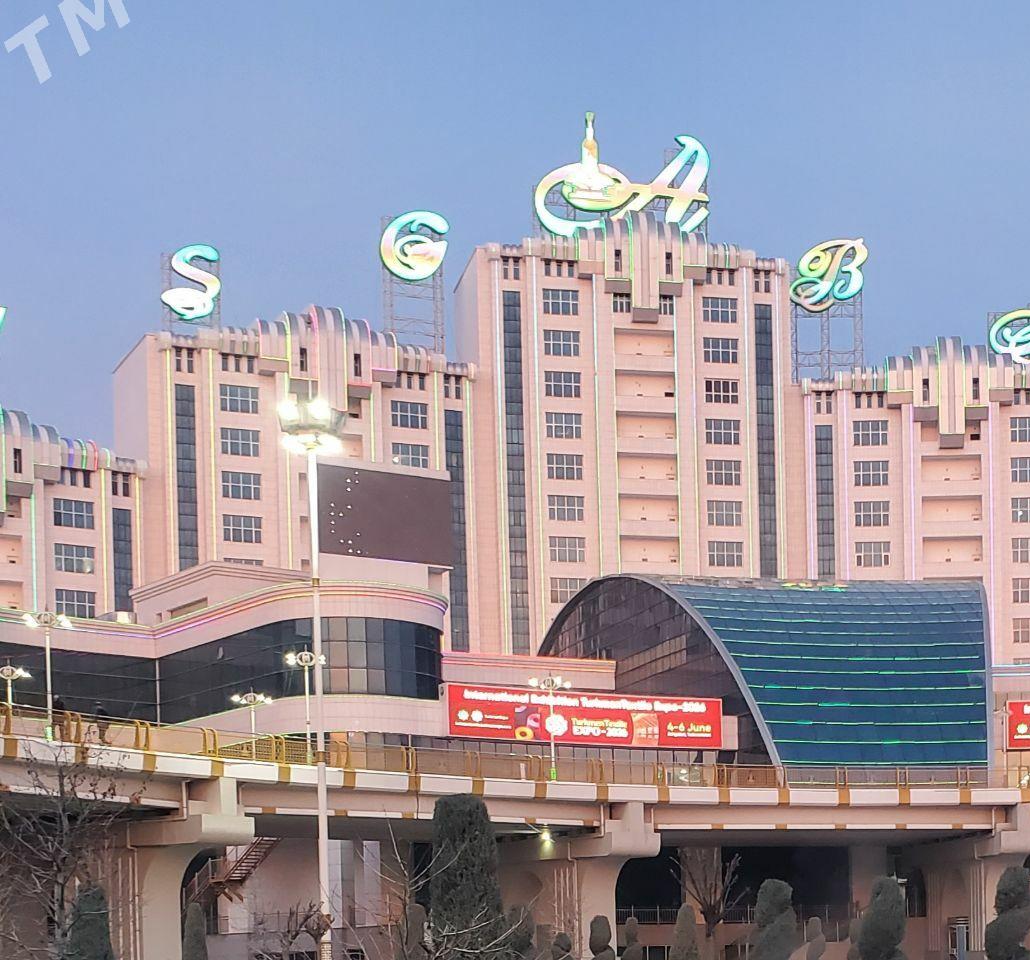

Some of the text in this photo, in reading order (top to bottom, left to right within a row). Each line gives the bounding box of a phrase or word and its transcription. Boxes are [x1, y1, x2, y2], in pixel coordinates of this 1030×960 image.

[380, 210, 450, 281] G
[789, 238, 868, 313] B
[687, 722, 712, 732] June
